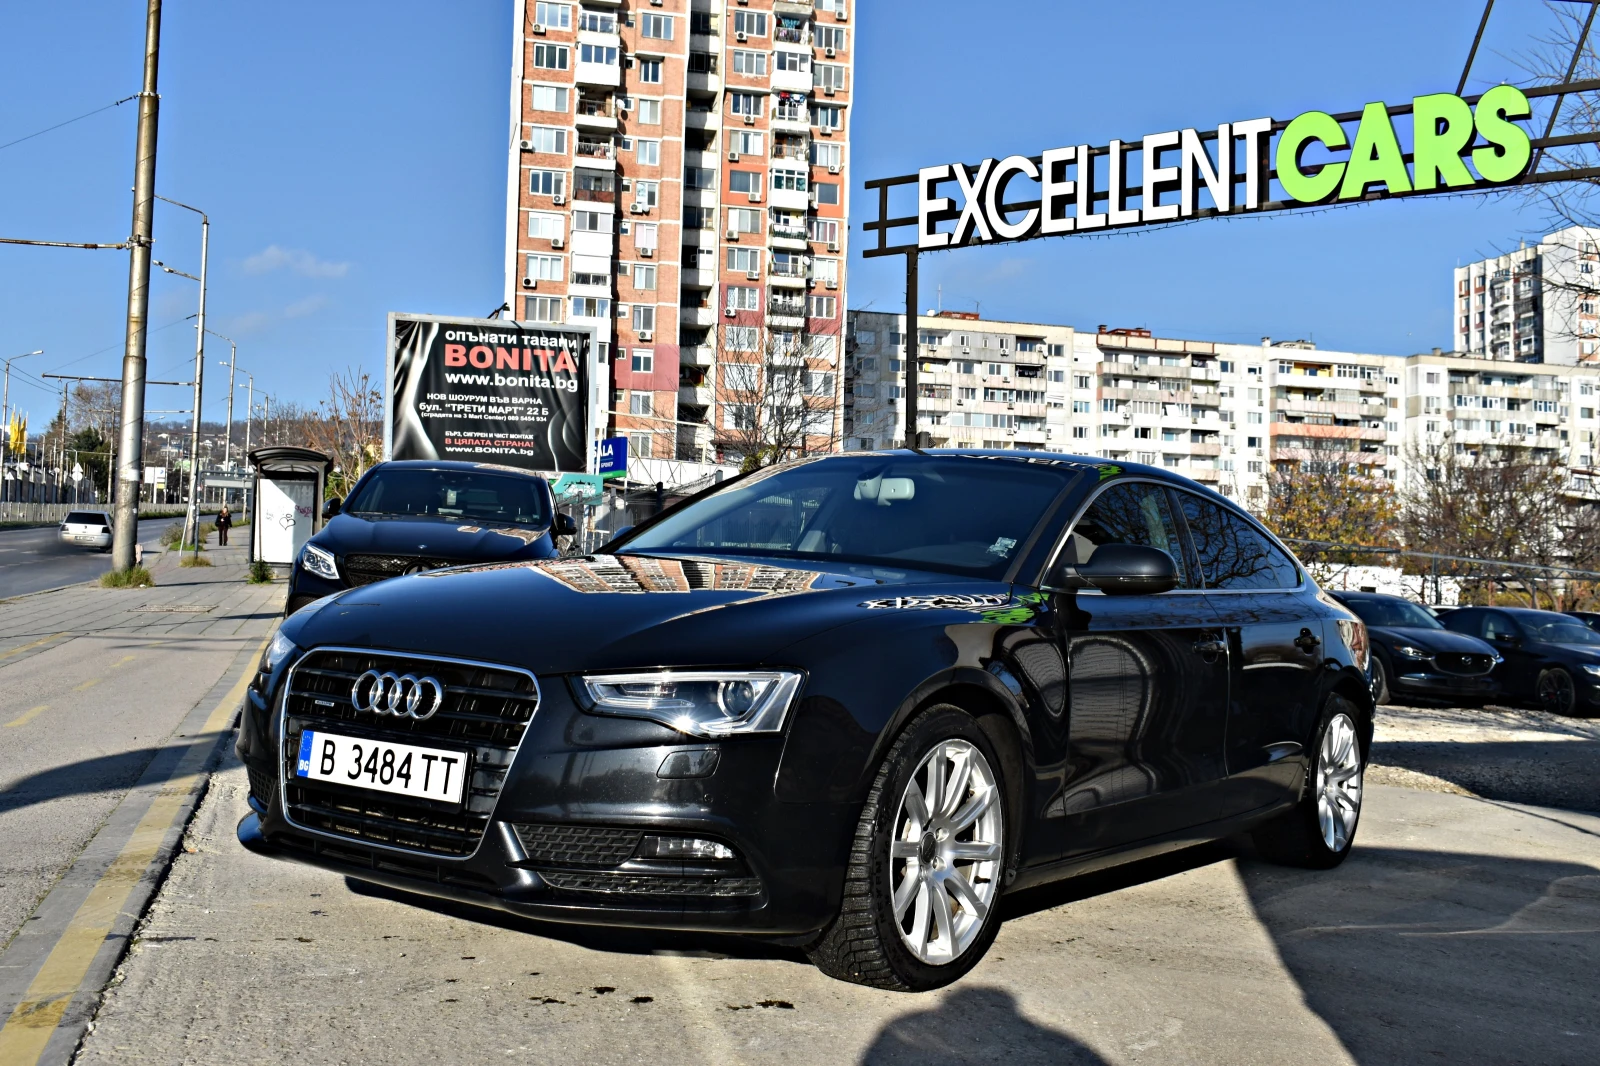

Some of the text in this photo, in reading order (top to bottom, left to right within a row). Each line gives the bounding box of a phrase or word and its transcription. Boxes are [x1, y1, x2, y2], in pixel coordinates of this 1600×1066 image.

[918, 85, 1531, 248] EXCELLENT CARS
[445, 330, 577, 348] опънати тавани
[444, 344, 577, 373] BONITA
[445, 373, 578, 392] www.bonita.bg
[449, 394, 487, 402] ШОУРУМ
[490, 396, 509, 404] ВЪВ
[511, 397, 542, 405] ВАРНА
[419, 402, 442, 412] бул.
[526, 407, 539, 415] 22
[541, 407, 549, 416] Б
[454, 438, 492, 446] ЦЯЛАТА
[494, 440, 534, 448] СТРАНА!
[445, 446, 534, 456] www.BONITA.bg
[299, 760, 310, 771] BG
